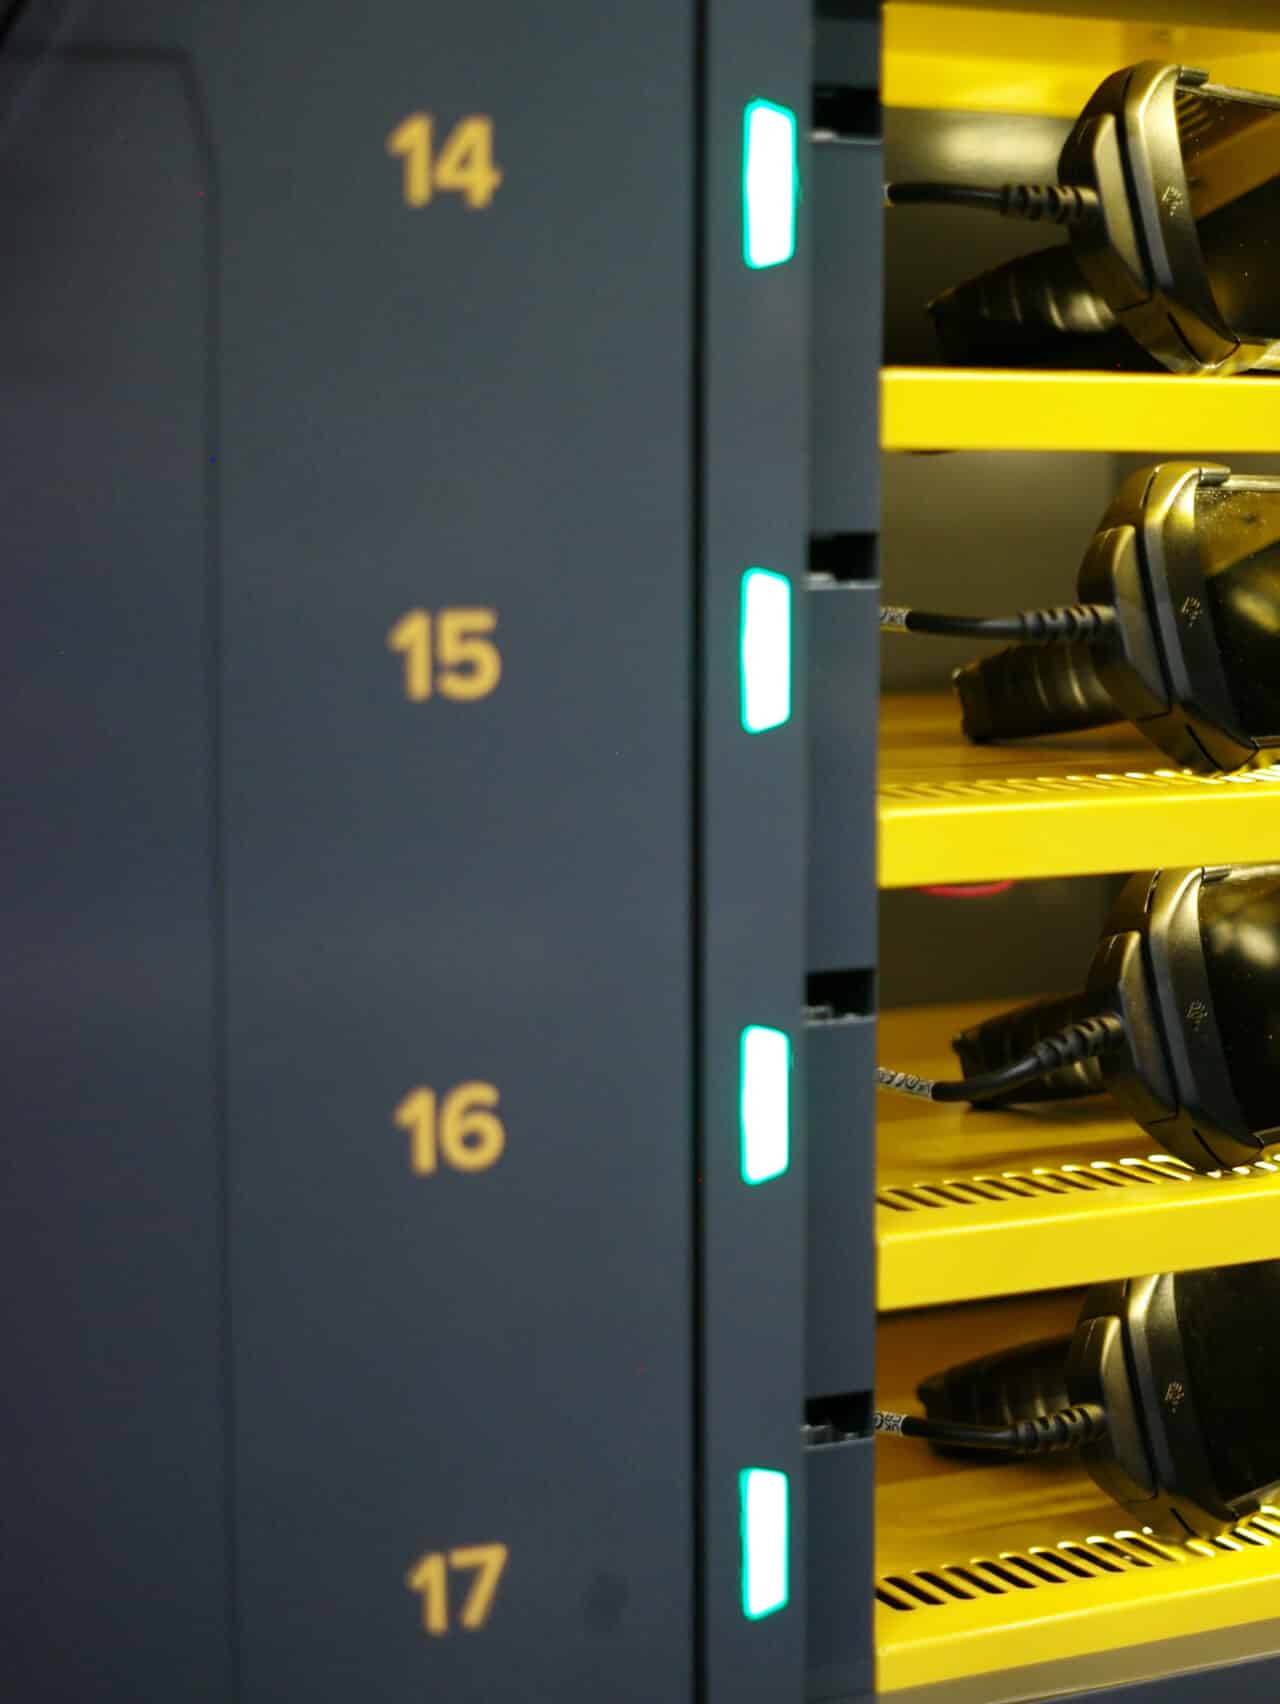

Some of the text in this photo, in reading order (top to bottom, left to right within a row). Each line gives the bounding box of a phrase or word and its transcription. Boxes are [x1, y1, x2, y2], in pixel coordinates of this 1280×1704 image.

[388, 113, 502, 210] 14
[388, 606, 502, 701] 15
[394, 1079, 506, 1176] 16
[407, 1541, 509, 1636] 17
